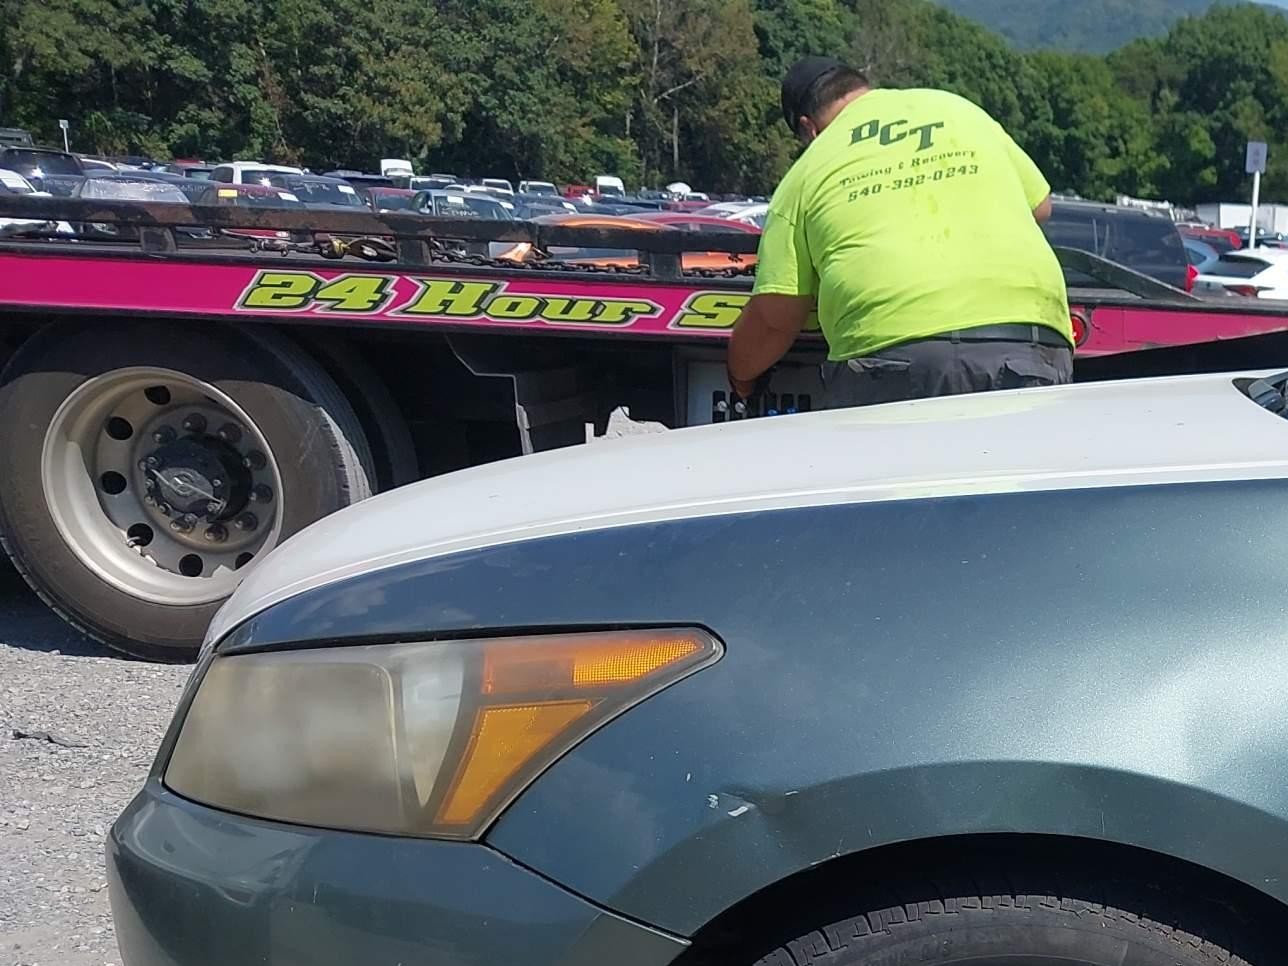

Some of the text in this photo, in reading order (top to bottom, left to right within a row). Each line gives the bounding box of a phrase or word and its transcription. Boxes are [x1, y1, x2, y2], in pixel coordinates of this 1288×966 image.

[849, 119, 944, 152] DCT
[910, 150, 976, 168] Recovery
[848, 164, 979, 202] 540-392-0243
[241, 273, 393, 310] 24
[400, 280, 653, 323] Hour
